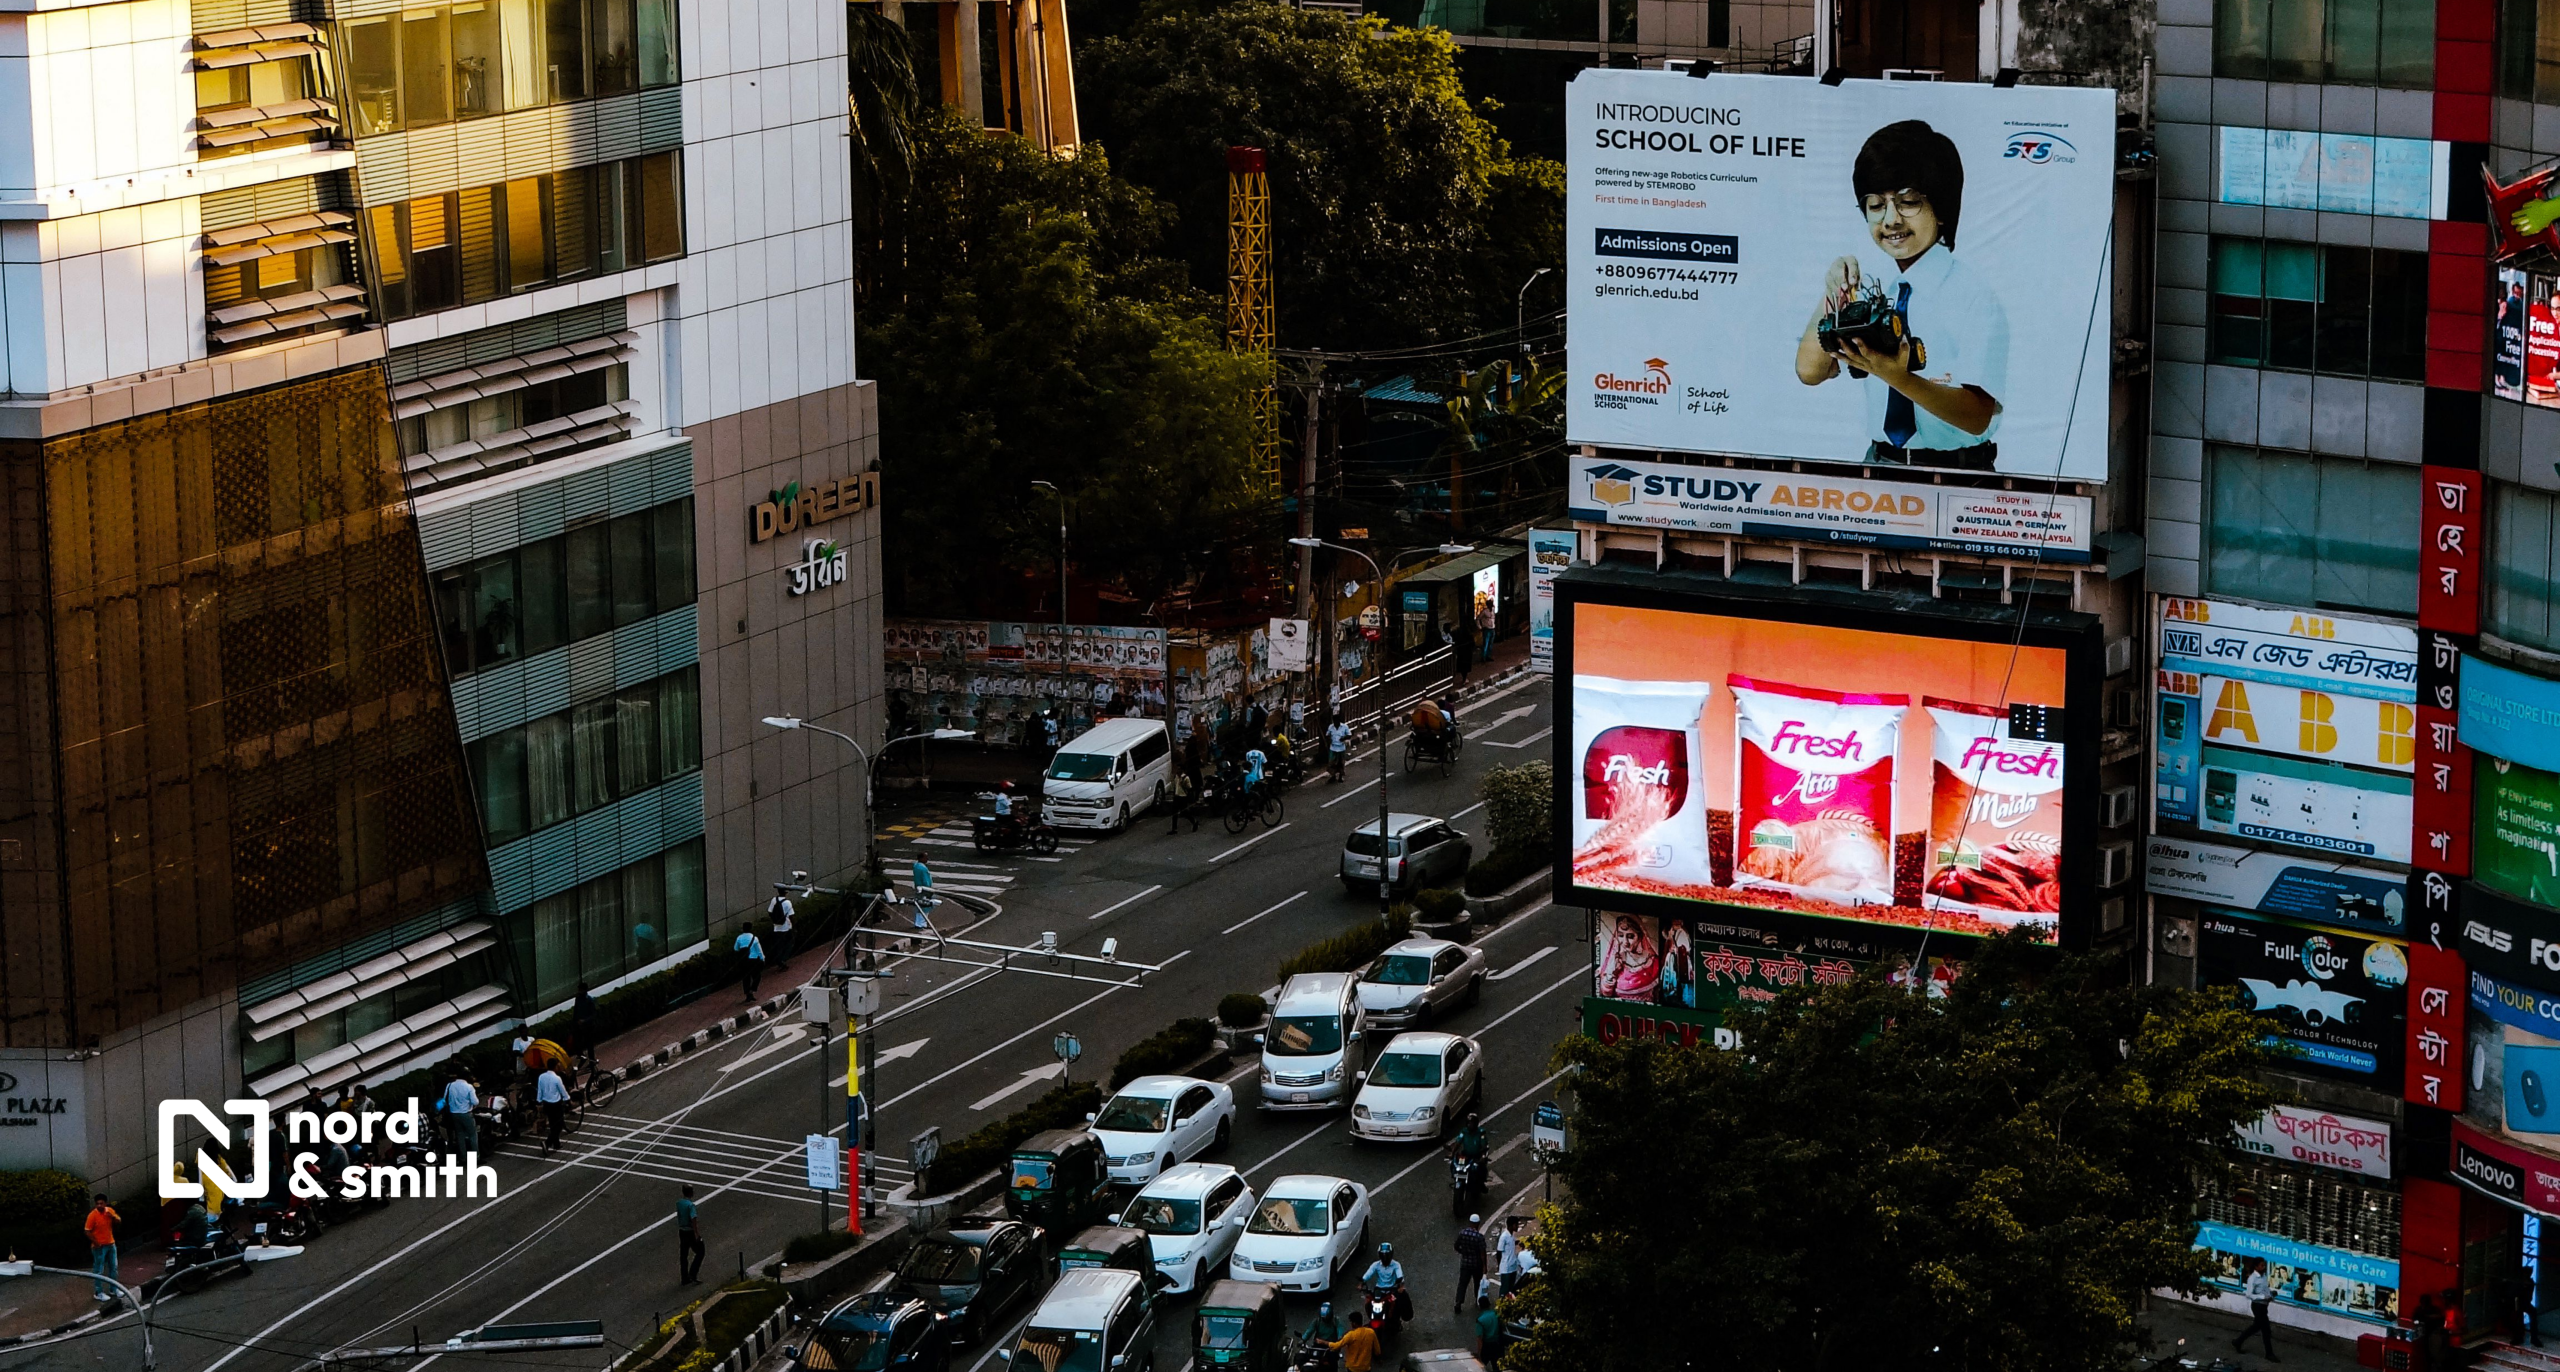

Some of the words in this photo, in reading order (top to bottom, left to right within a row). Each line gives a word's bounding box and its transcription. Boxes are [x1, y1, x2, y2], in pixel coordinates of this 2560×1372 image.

[1596, 102, 1741, 126] INTRODUCING
[1595, 128, 1702, 153] SCHOOL
[1710, 134, 1744, 155] OF
[1752, 136, 1806, 158] LIFE
[2003, 141, 2052, 159] STS
[2053, 154, 2075, 163] Group
[1595, 168, 1630, 178] Offering
[1632, 170, 1668, 181] new-age
[1671, 171, 1708, 181] Robotics
[1710, 174, 1758, 183] Curriculum
[1595, 179, 1632, 188] powered
[1634, 180, 1644, 190] by
[1646, 181, 1696, 191] STEMROBO
[1595, 194, 1615, 204] First
[1618, 196, 1639, 205] time
[1641, 197, 1650, 206] in
[1652, 198, 1707, 210] Bangladesh
[1600, 235, 1687, 253] Admissions
[1690, 240, 1732, 257] Open
[1596, 265, 1738, 285] +8809677444777
[1595, 284, 1699, 300] glenrich.edu.bd
[2529, 316, 2555, 335] Free
[1594, 373, 1667, 394] Glenrich
[1687, 387, 1729, 399] School
[1594, 393, 1658, 405] INTERNATIONAL
[1594, 400, 1628, 410] SCHOOL
[1687, 401, 1701, 414] of
[1704, 401, 1729, 415] Life
[1643, 474, 1762, 503] STUDY
[1769, 484, 1925, 516] ABROAD
[1996, 496, 2014, 505] STUDY
[2015, 497, 2030, 506] IN
[1680, 501, 1734, 514] Worldwide
[1736, 505, 1792, 518] Admission
[1794, 510, 1814, 520] and
[1817, 512, 1839, 522] Visa
[1843, 515, 1886, 526] Process
[1965, 516, 2012, 527] AUSTRALIA
[2024, 520, 2067, 531] GERMANY
[1972, 506, 2008, 516] CANADA
[2021, 509, 2038, 517] USA
[2050, 511, 2062, 520] UK
[1959, 527, 1978, 536] NEW
[1980, 529, 2018, 539] ZEALAND
[2030, 532, 2073, 543] MALAYSIA
[2436, 482, 2467, 596] তাহের
[1964, 543, 1982, 552] 019
[1983, 544, 1996, 553] 55
[1998, 545, 2010, 554] 66
[2011, 547, 2025, 555] 00
[2164, 598, 2210, 623] ABB
[2289, 614, 2335, 639] ABB
[2205, 638, 2248, 660] এন
[2253, 643, 2313, 668] জেড
[2158, 670, 2199, 695] ABB
[2505, 700, 2539, 722] STORE
[1771, 720, 1863, 761] Fresh
[1962, 737, 2060, 780] Fresh
[1772, 769, 1839, 806] Atta
[1970, 792, 2037, 829] Maida
[2244, 826, 2367, 853] 01714-093601
[2463, 920, 2512, 953] ASUS
[1701, 945, 1755, 986] কুইক
[2472, 970, 2494, 998] FIND
[2497, 982, 2535, 1014] YOUR
[2326, 1032, 2378, 1050] TECHNOLOGY
[2309, 1048, 2326, 1060] Dark
[2328, 1051, 2349, 1063] World
[2350, 1056, 2373, 1068] Never
[7, 1098, 67, 1114] PLAZA
[2292, 1146, 2363, 1169] Optics
[2460, 1147, 2515, 1191] Lenovo
[2235, 1235, 2288, 1258] Al-Madina
[2291, 1248, 2325, 1265] Optics
[2328, 1256, 2337, 1267] &
[2340, 1257, 2359, 1274] Eye
[2361, 1264, 2387, 1279] Care
